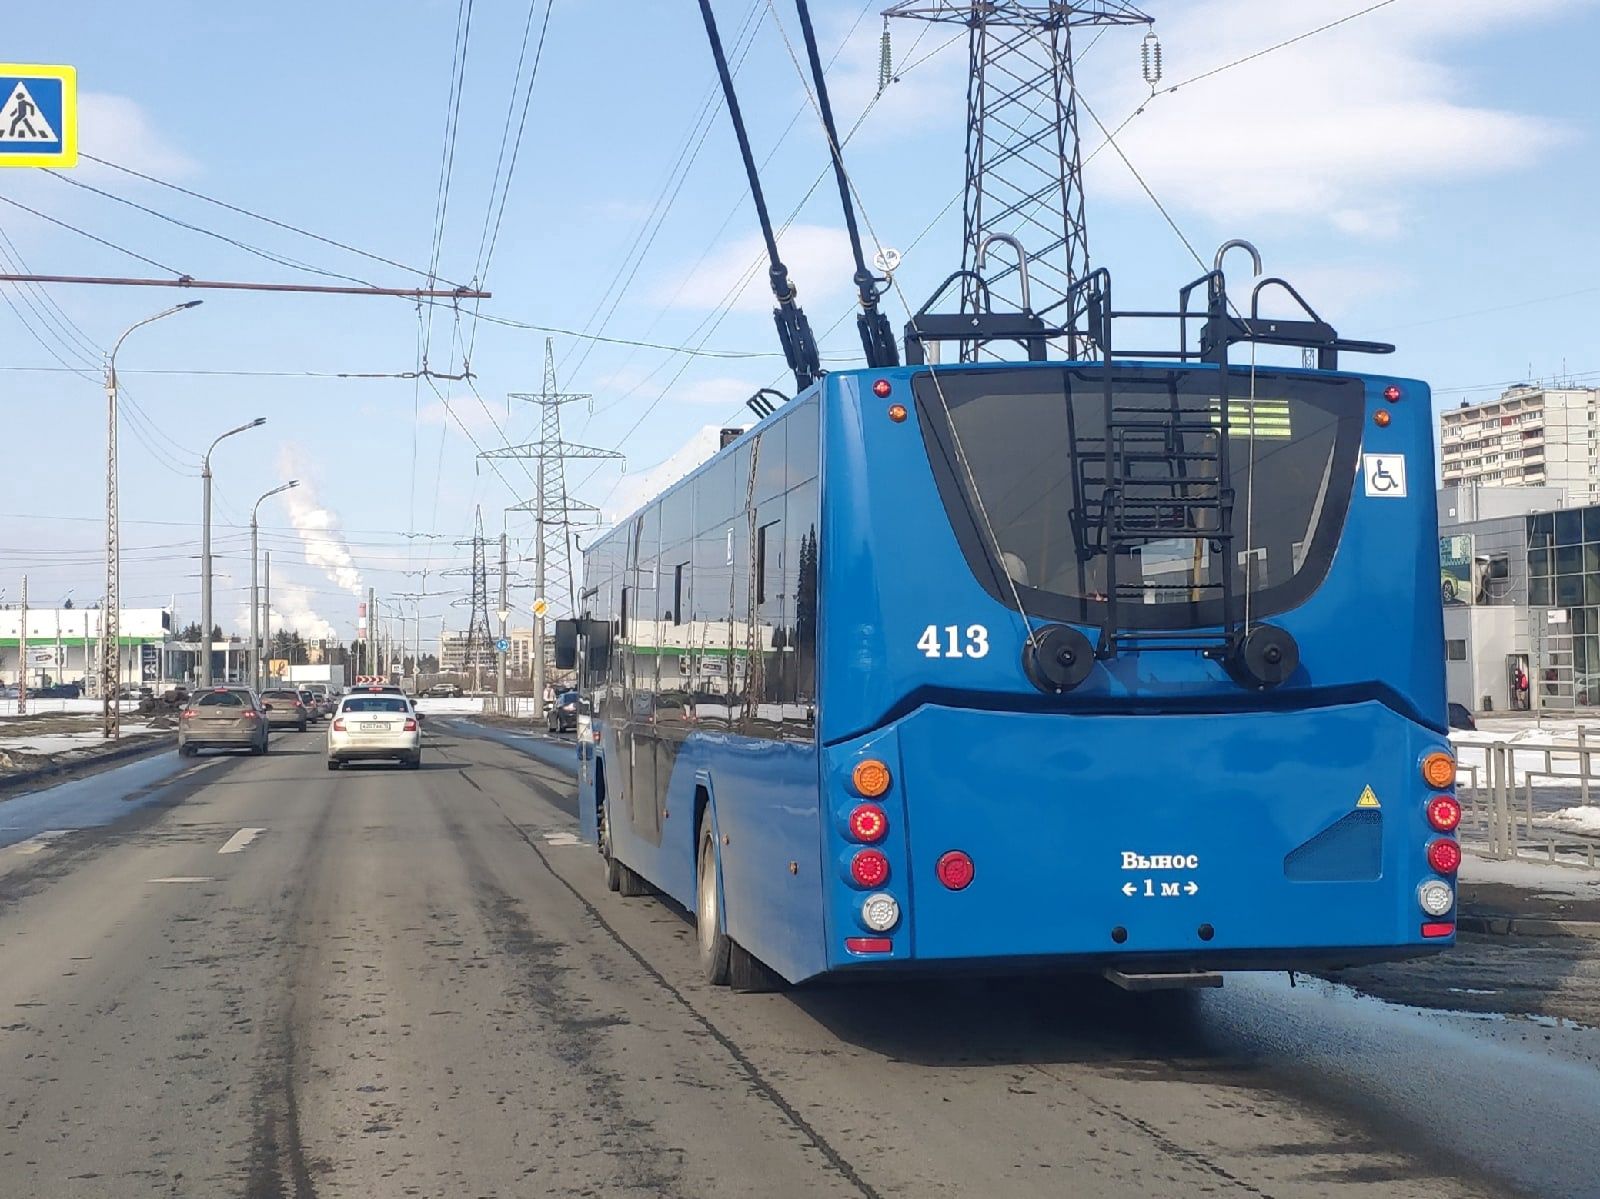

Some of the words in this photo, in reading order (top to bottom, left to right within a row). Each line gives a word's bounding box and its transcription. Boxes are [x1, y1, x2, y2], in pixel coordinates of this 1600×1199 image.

[916, 624, 989, 658] 413
[1120, 851, 1198, 869] Вынос
[1143, 878, 1155, 897] 1
[1160, 882, 1180, 897] м
